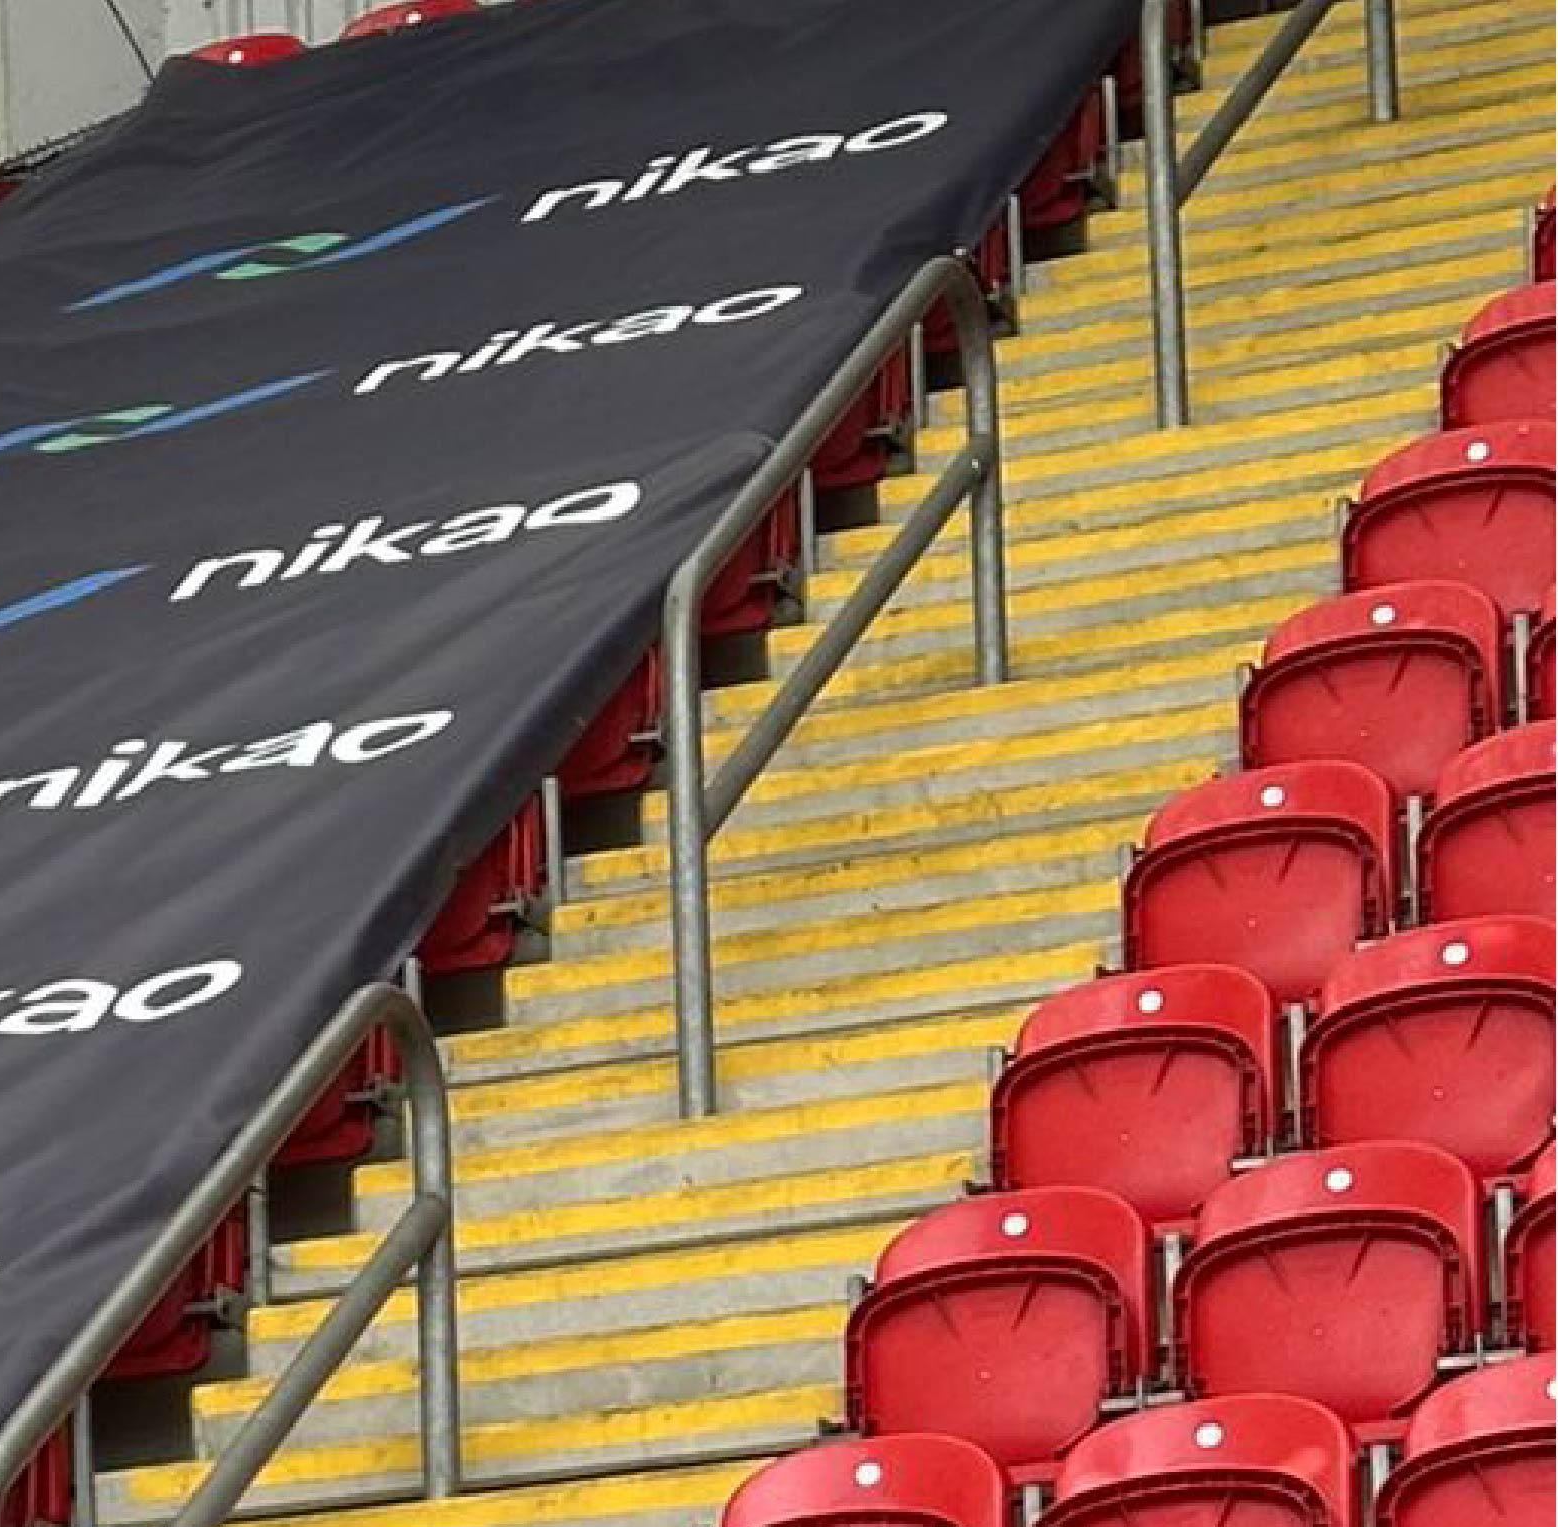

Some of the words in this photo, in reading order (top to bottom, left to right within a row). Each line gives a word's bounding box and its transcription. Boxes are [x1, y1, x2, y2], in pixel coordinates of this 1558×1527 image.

[519, 110, 949, 223] nikao
[352, 286, 803, 394] nikao
[169, 481, 642, 604] nikao
